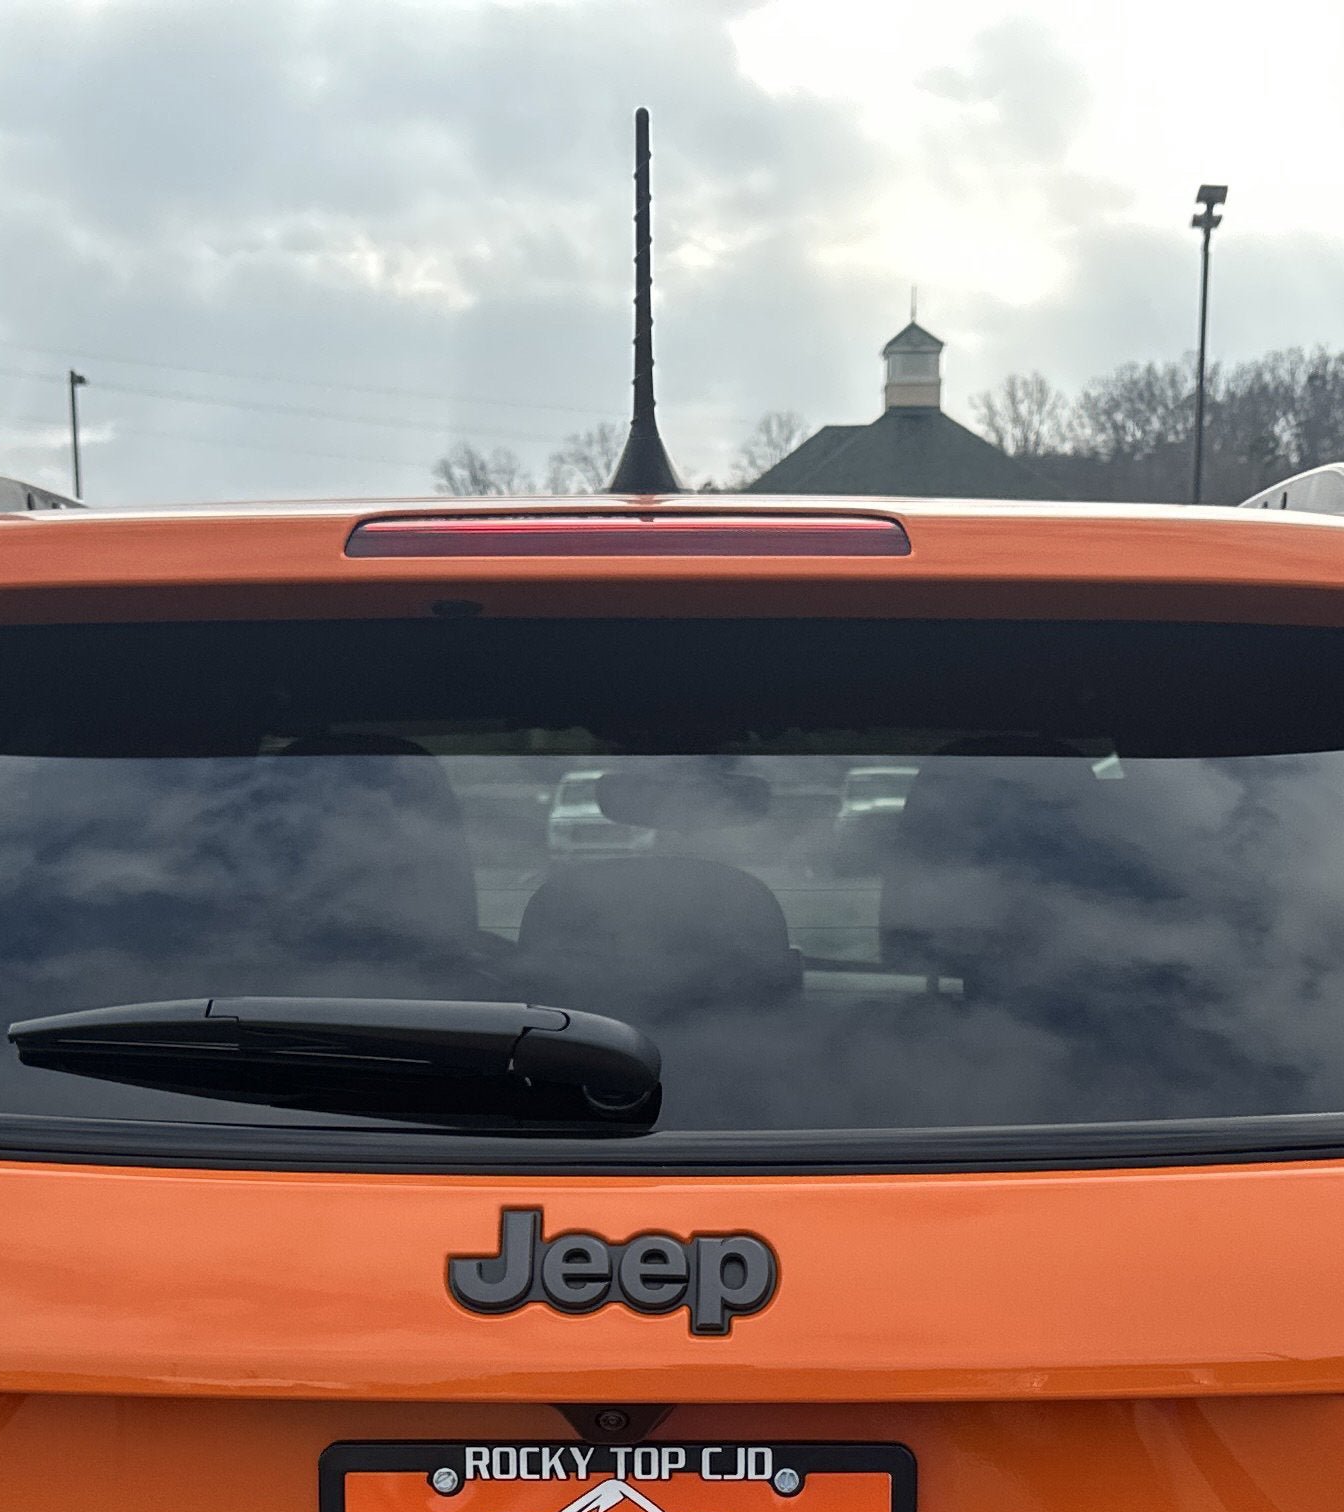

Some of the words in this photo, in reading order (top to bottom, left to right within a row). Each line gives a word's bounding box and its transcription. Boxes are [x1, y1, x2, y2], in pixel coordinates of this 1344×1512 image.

[449, 1208, 776, 1336] Jeep
[465, 1447, 594, 1481] ROCKY
[609, 1447, 686, 1480] TOP
[701, 1447, 773, 1482] CJD
